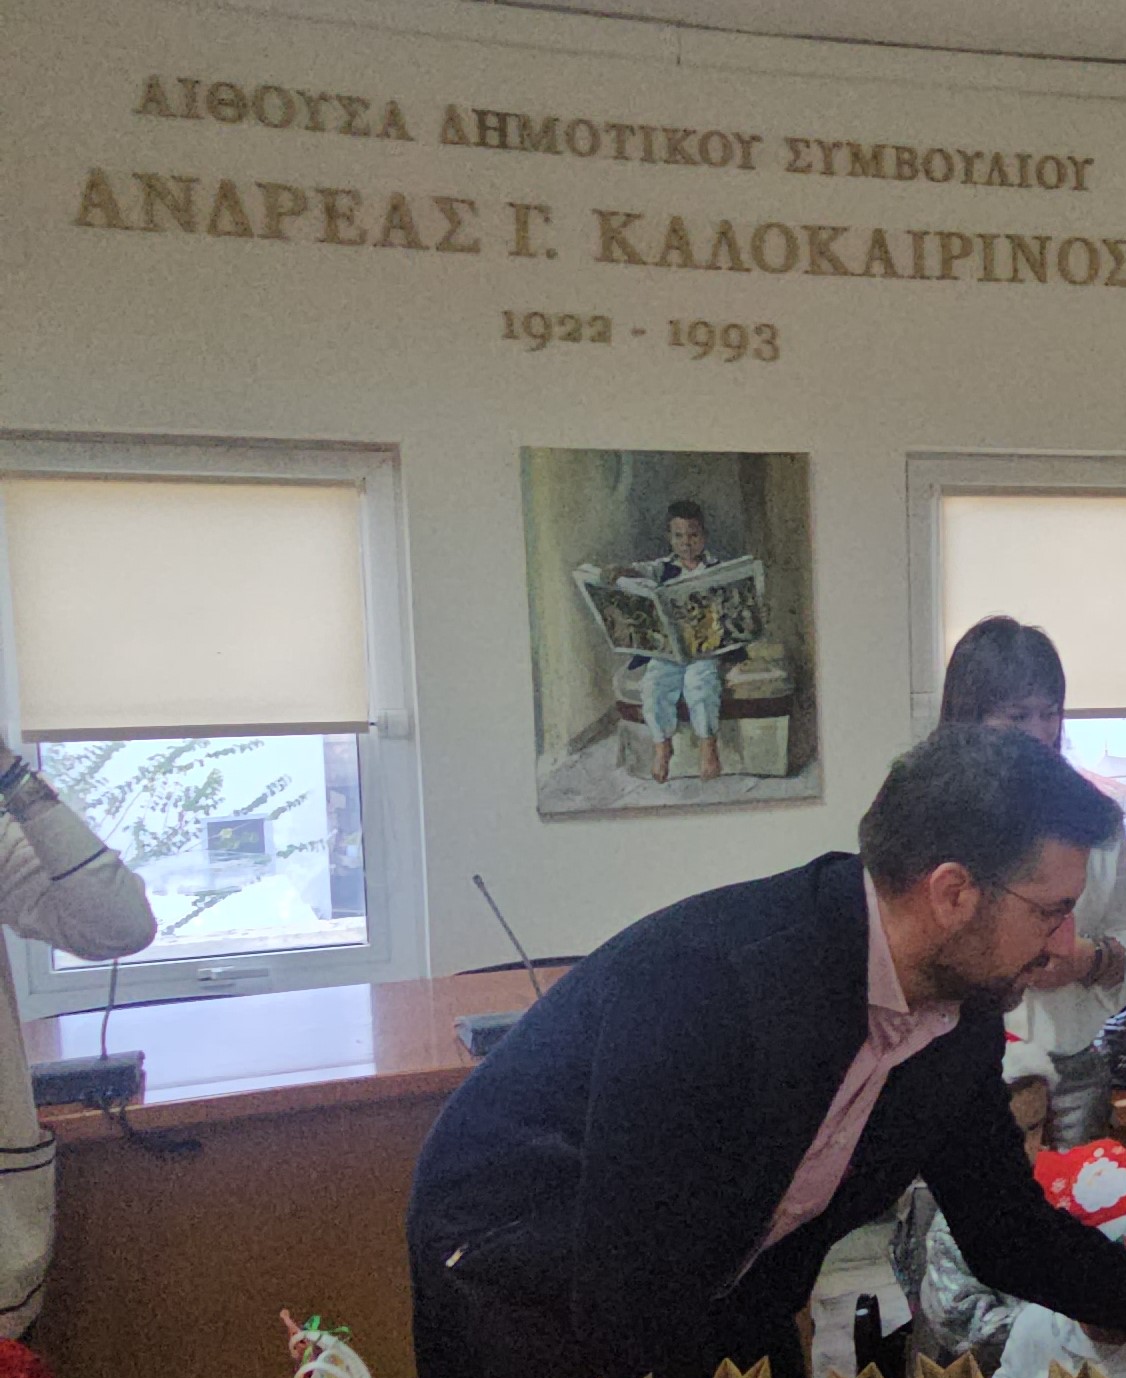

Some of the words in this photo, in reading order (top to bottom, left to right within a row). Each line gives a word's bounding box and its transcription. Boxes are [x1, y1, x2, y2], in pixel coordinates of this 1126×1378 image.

[132, 74, 414, 142] ΑΙΘΟΥΣΑ
[438, 103, 762, 170] ΔΗΜΟΤΙΚΟΥ
[784, 137, 1095, 192] ΣΥΜΒΟΥΛΙΟΥ
[73, 168, 481, 254] ΑΝΔΡΕΑΣ
[507, 201, 558, 259] Γ.
[501, 309, 612, 352] 1922
[668, 318, 780, 363] 1993
